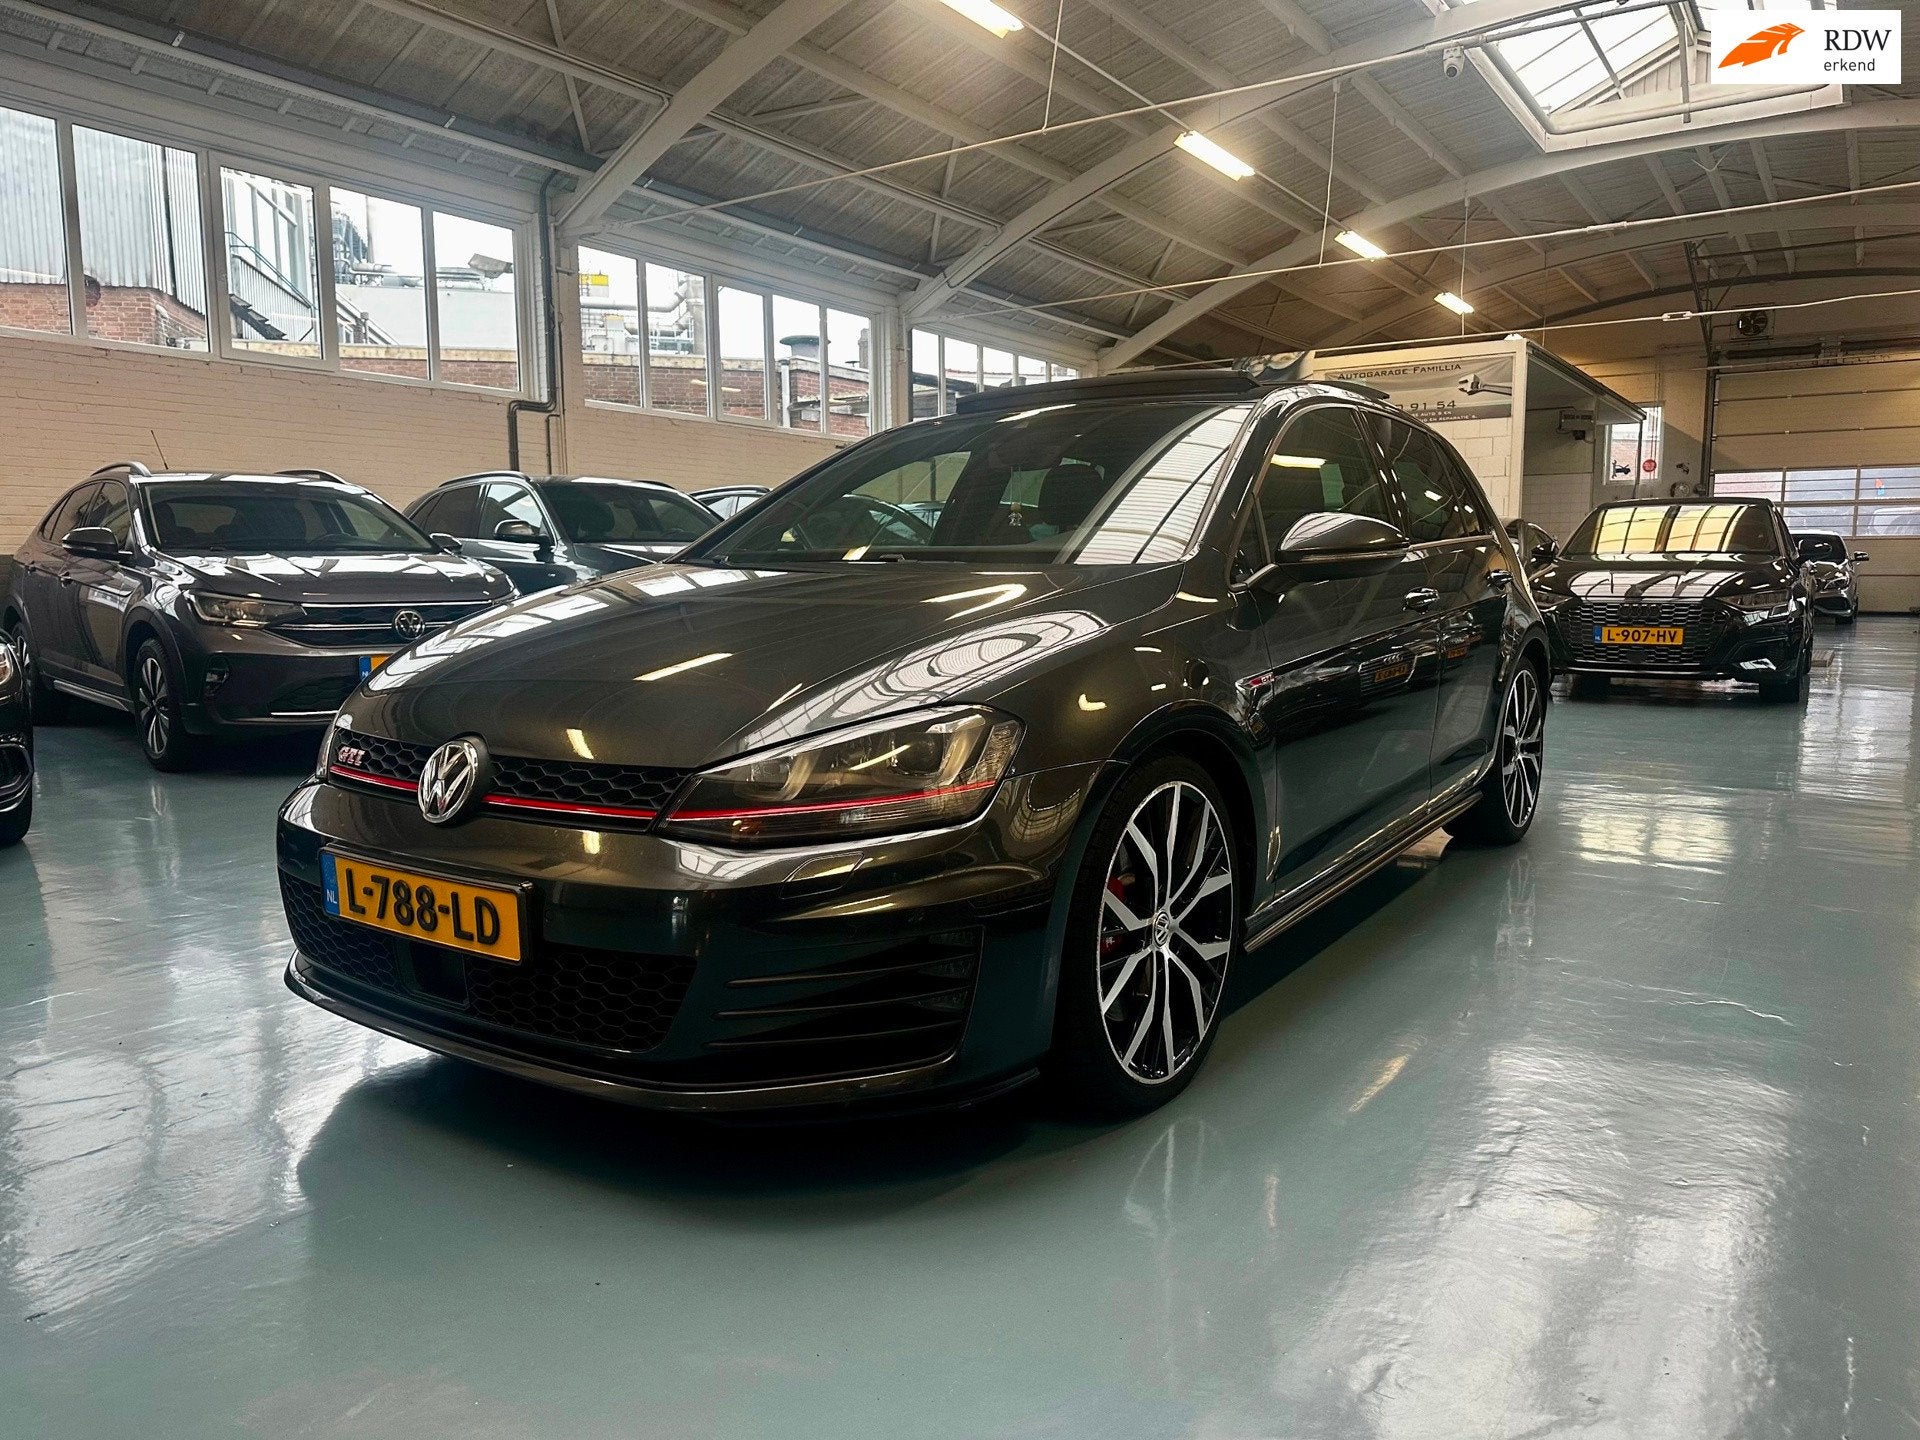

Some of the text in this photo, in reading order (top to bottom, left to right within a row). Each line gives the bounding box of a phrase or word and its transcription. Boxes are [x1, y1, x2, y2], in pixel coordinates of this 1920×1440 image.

[1410, 402, 1427, 411] 91
[1436, 400, 1457, 410] 54
[1607, 629, 1677, 642] L-907-HV
[337, 745, 366, 767] GTI
[326, 867, 500, 946] NL L-788-LD
